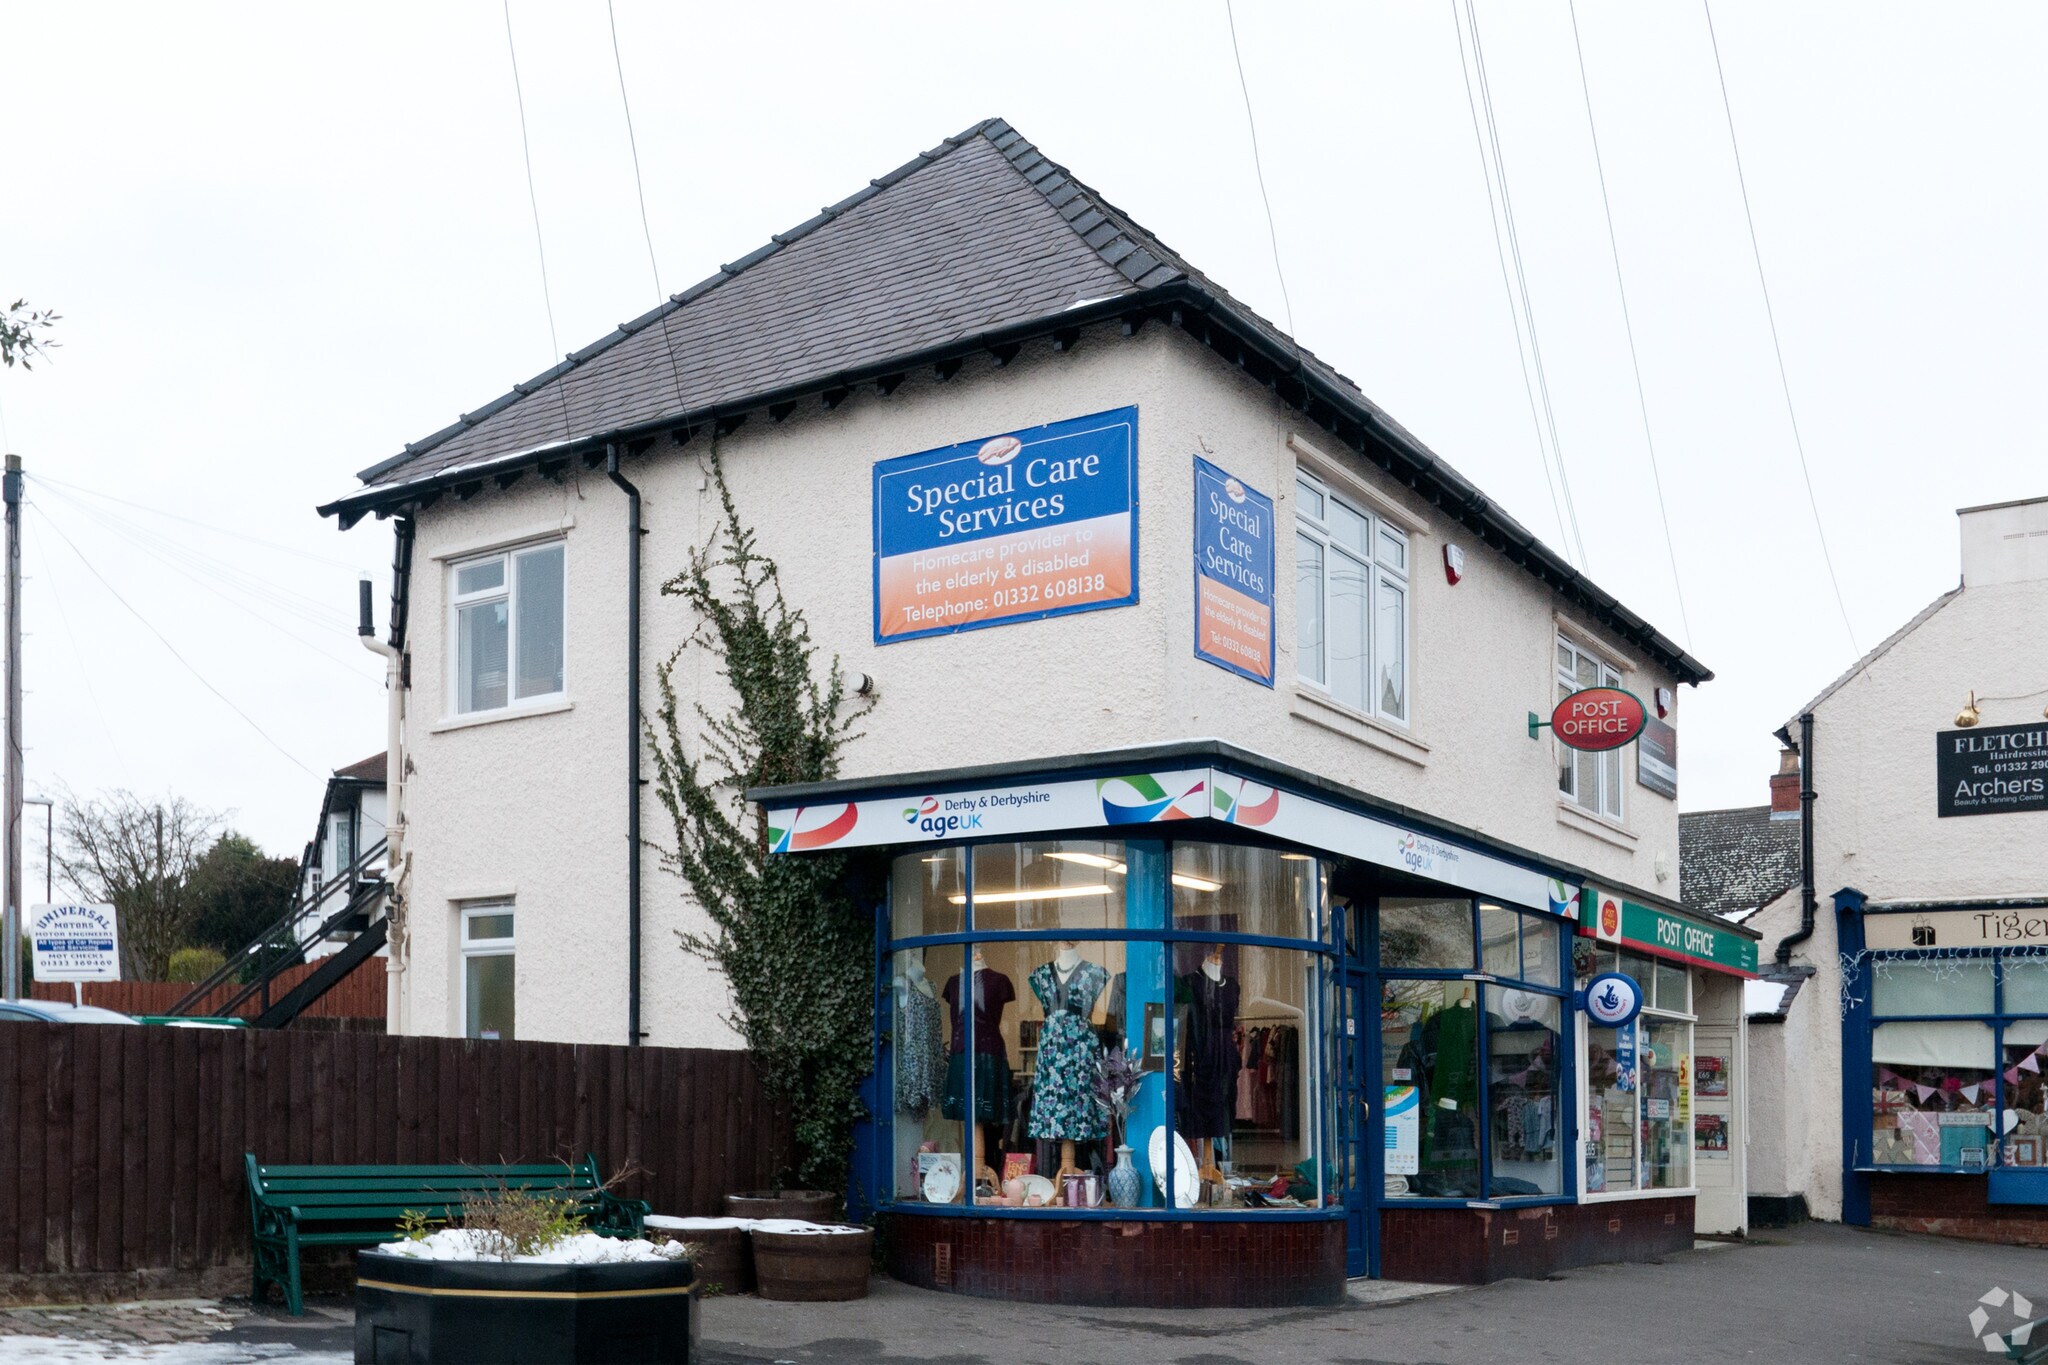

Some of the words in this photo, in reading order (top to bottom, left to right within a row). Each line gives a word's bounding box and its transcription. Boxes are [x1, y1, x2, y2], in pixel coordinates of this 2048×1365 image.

[908, 464, 1014, 516] Special
[1026, 454, 1100, 488] Care
[939, 494, 1065, 538] Services
[1210, 491, 1261, 539] Special
[912, 547, 994, 573] Homecare
[1000, 529, 1070, 561] provider
[1076, 528, 1093, 542] to
[1220, 526, 1253, 562] Care
[916, 578, 942, 595] the
[946, 568, 999, 587] elderly
[1004, 563, 1016, 579] &
[1022, 550, 1089, 576] disabled
[1206, 545, 1264, 594] Services
[903, 598, 989, 622] Telephone:
[993, 585, 1039, 608] 01332
[1044, 574, 1106, 599] 608138
[1203, 588, 1235, 612] Homecare
[1235, 606, 1260, 622] provider
[1204, 605, 1215, 618] the
[1216, 611, 1236, 630] elderly
[1243, 624, 1266, 641] disabled
[1222, 636, 1239, 653] 01332
[1572, 700, 1622, 717] POST
[1562, 718, 1628, 735] OFFICE
[1972, 765, 1991, 774] Tel.
[1994, 762, 2028, 772] 01332
[1955, 778, 2044, 798] Archers
[945, 798, 976, 811] Derby
[979, 796, 987, 808] &
[991, 791, 1050, 807] Derbyshire
[1989, 796, 2017, 804] Tanning
[1417, 840, 1431, 855] Derby
[1431, 844, 1435, 854] &
[1436, 846, 1459, 862] Derbyshire
[36, 906, 111, 929] UNIVERSAL
[1603, 917, 1616, 929] OFFICE
[1605, 908, 1615, 917] POST
[1657, 918, 1682, 946] POST
[1684, 926, 1714, 957] OFFICE
[1697, 1071, 1710, 1080] £65
